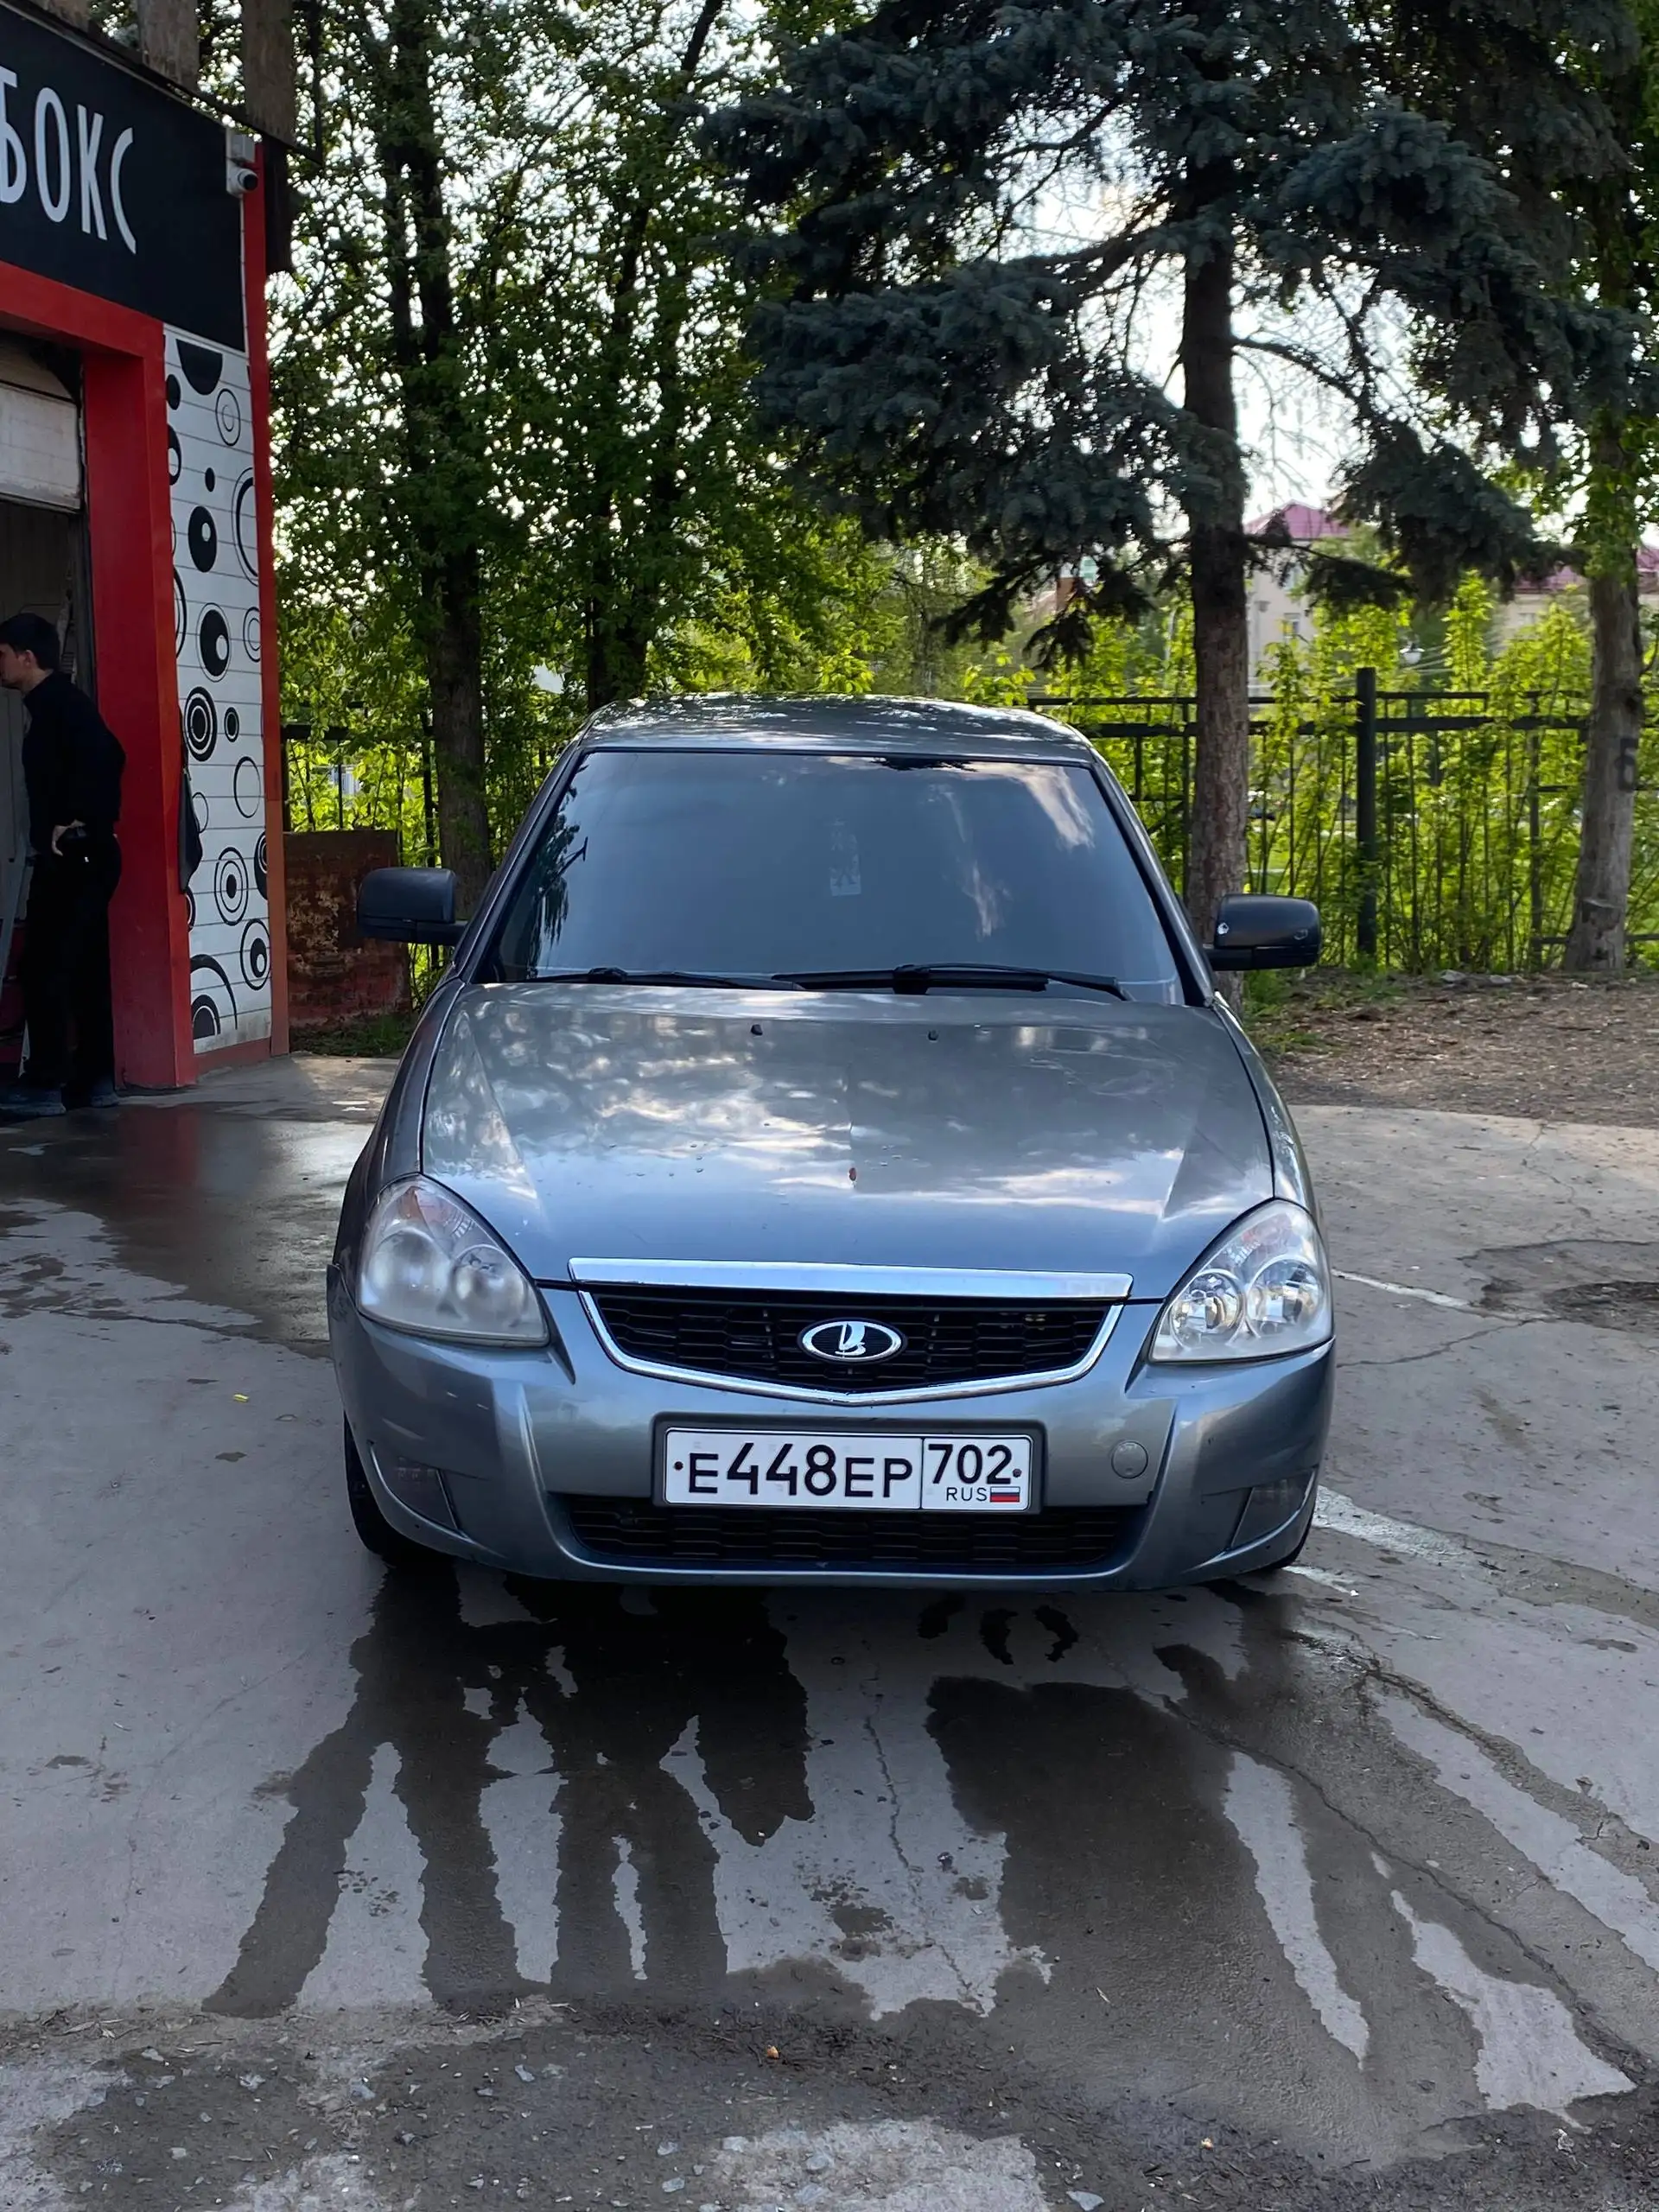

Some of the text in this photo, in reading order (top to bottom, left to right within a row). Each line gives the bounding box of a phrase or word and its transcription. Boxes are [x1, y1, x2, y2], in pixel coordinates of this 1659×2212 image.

[0, 66, 137, 254] БОКС
[688, 1442, 1013, 1498] Е448ЕР 702
[945, 1486, 987, 1503] RUS
